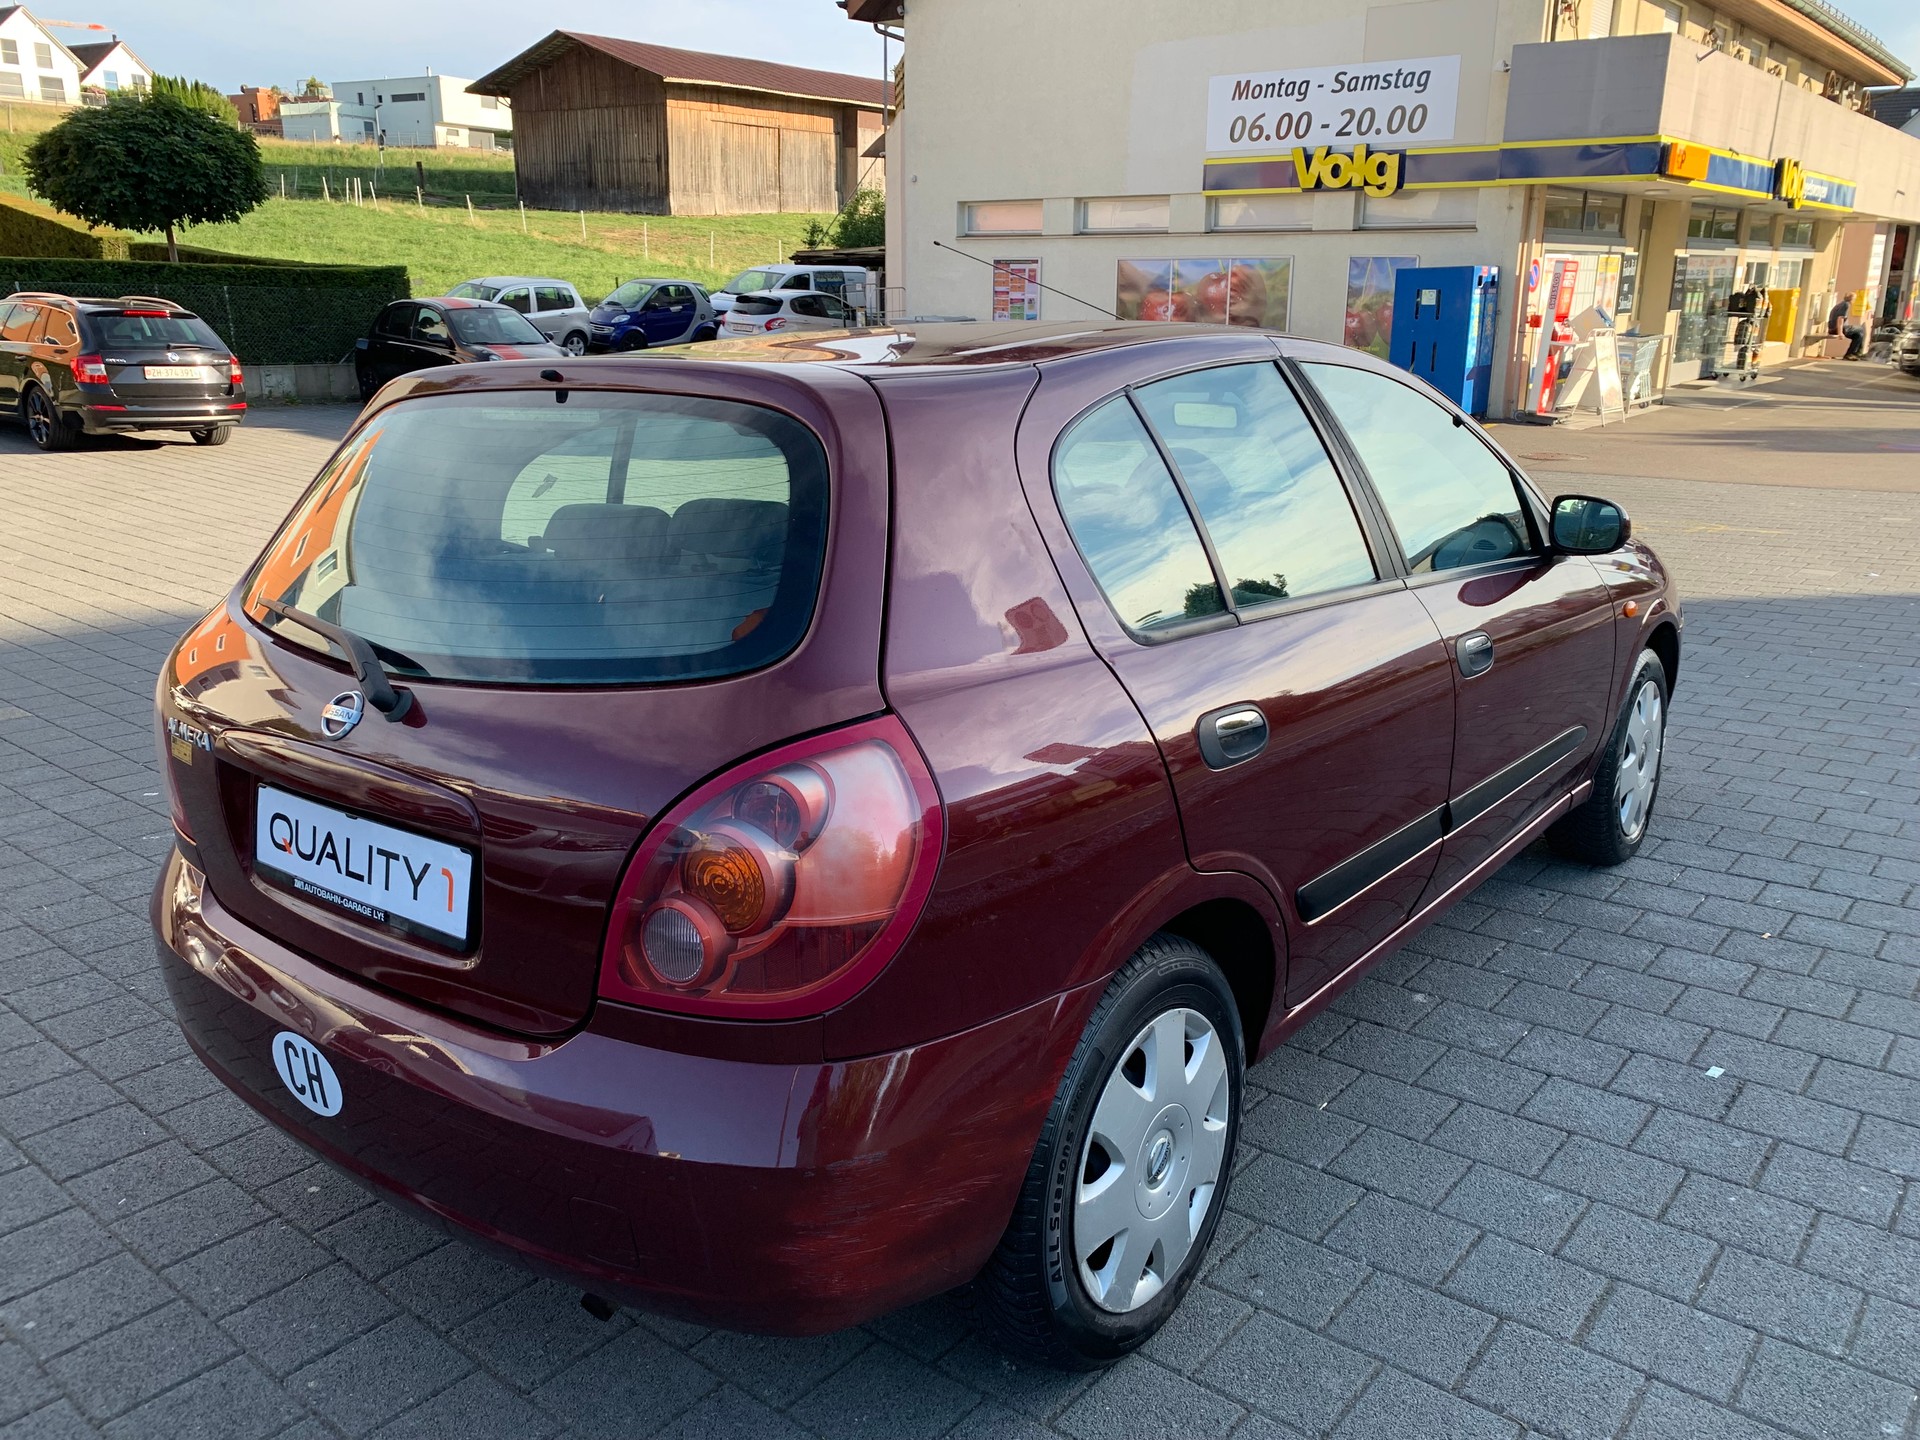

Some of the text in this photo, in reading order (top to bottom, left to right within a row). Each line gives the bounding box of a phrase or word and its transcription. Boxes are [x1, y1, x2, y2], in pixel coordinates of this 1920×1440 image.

[1231, 79, 1310, 101] Montag
[1331, 68, 1431, 94] Samstag
[1229, 111, 1312, 143] 06.00
[1335, 103, 1428, 137] 20.00
[1291, 143, 1400, 198] Volg
[1549, 272, 1561, 309] SWISSLOS
[324, 706, 354, 720] SSAN
[167, 717, 211, 751] ALMERA
[304, 884, 372, 917] AUTOBAHN-GARAGE
[284, 1040, 329, 1109] CH
